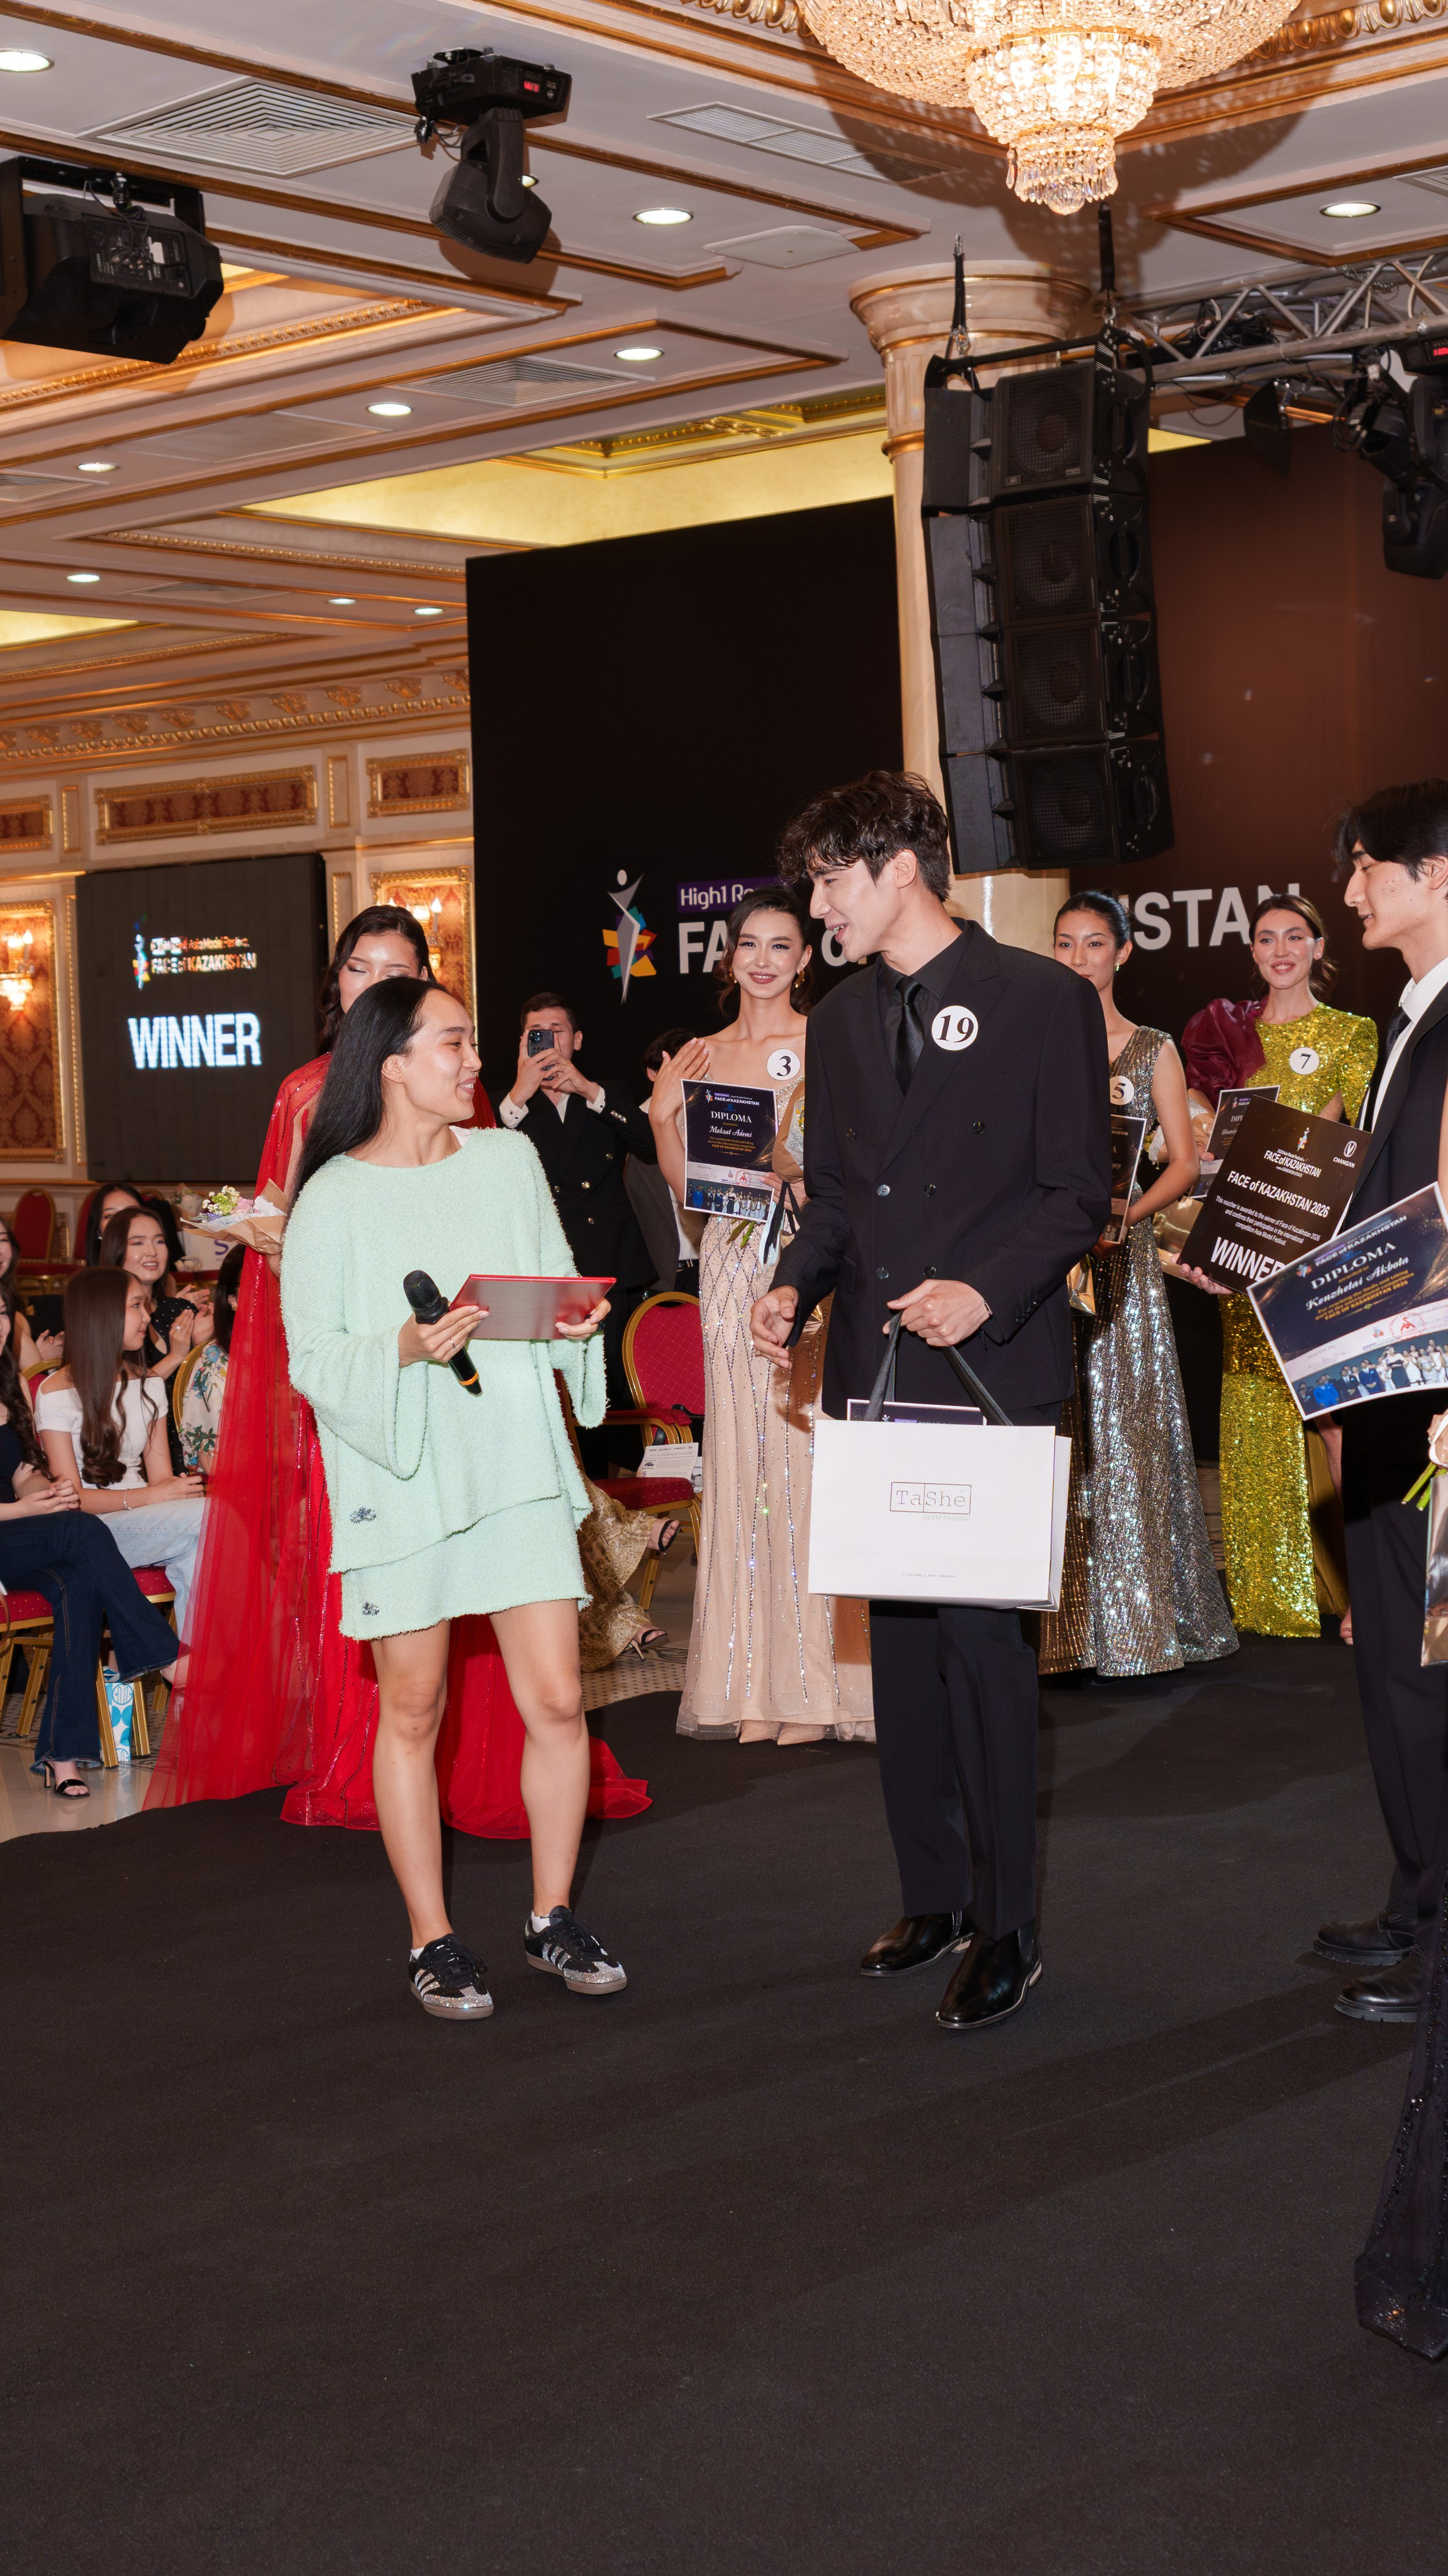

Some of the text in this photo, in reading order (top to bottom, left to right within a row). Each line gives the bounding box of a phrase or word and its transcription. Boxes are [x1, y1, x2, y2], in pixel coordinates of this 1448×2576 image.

[681, 883, 727, 909] High1
[128, 1013, 262, 1069] WINNER
[936, 1014, 974, 1043] 19
[777, 1055, 791, 1077] 3
[1300, 1053, 1312, 1069] 7
[1112, 1082, 1126, 1099] 5
[711, 1111, 752, 1123] DIPLOMA
[1264, 1150, 1322, 1178] FACE of KAZAKHSTAN
[1333, 1157, 1356, 1169] CHANGAN
[1227, 1170, 1330, 1218] FACE of KAZAKHSTAN 2026
[1223, 1199, 1237, 1208] voucher
[1239, 1206, 1256, 1216] awarded
[1264, 1216, 1276, 1224] winner
[1279, 1220, 1288, 1229] Face
[1291, 1226, 1312, 1238] Kazakhstan
[1232, 1212, 1247, 1221] confirms
[1253, 1221, 1274, 1232] participation
[1283, 1231, 1305, 1244] international
[1235, 1221, 1255, 1233] competition
[1262, 1231, 1274, 1240] Model
[1315, 1252, 1338, 1267] FACE
[1347, 1215, 1407, 1250] KAZAKHSTAN
[1310, 1243, 1396, 1289] DIPLOMA
[896, 1489, 966, 1507] TaShé
